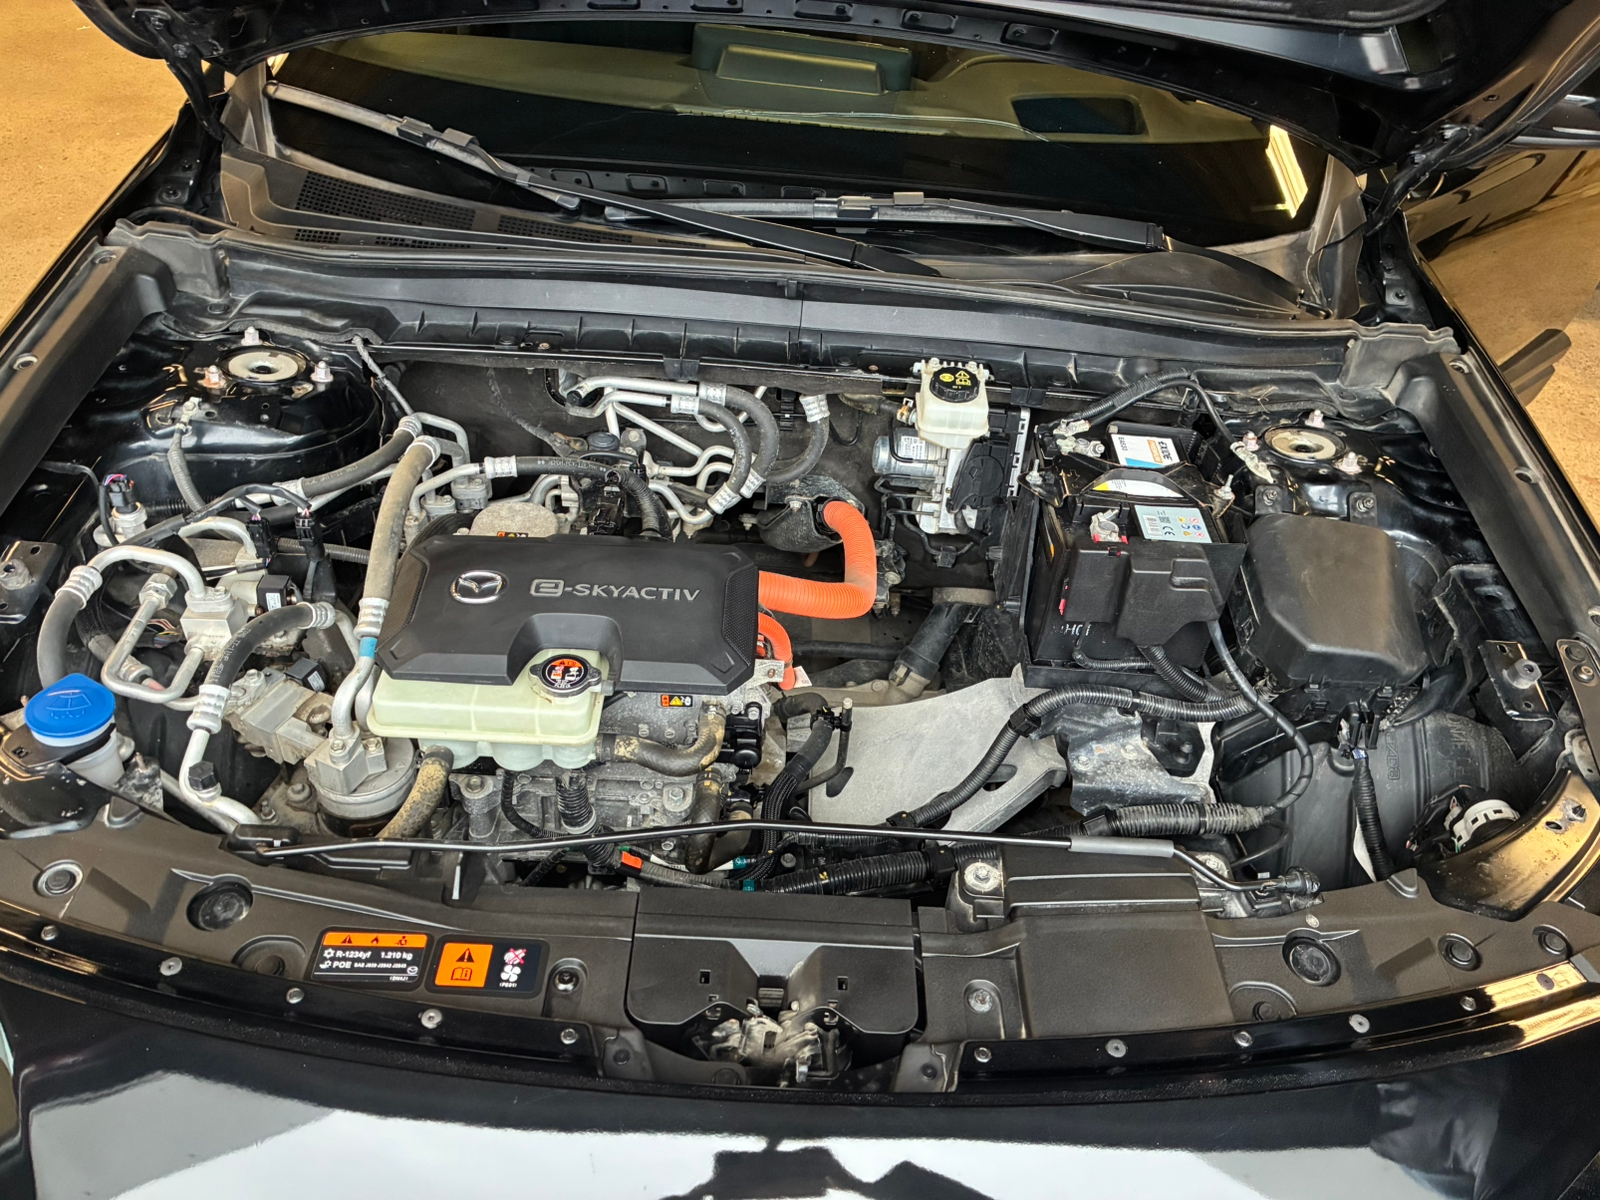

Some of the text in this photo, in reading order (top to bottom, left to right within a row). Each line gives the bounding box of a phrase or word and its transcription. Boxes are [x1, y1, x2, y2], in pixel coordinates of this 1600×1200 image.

[335, 950, 413, 961] R-1234yf 1.210 kg
[332, 961, 352, 969] POE
